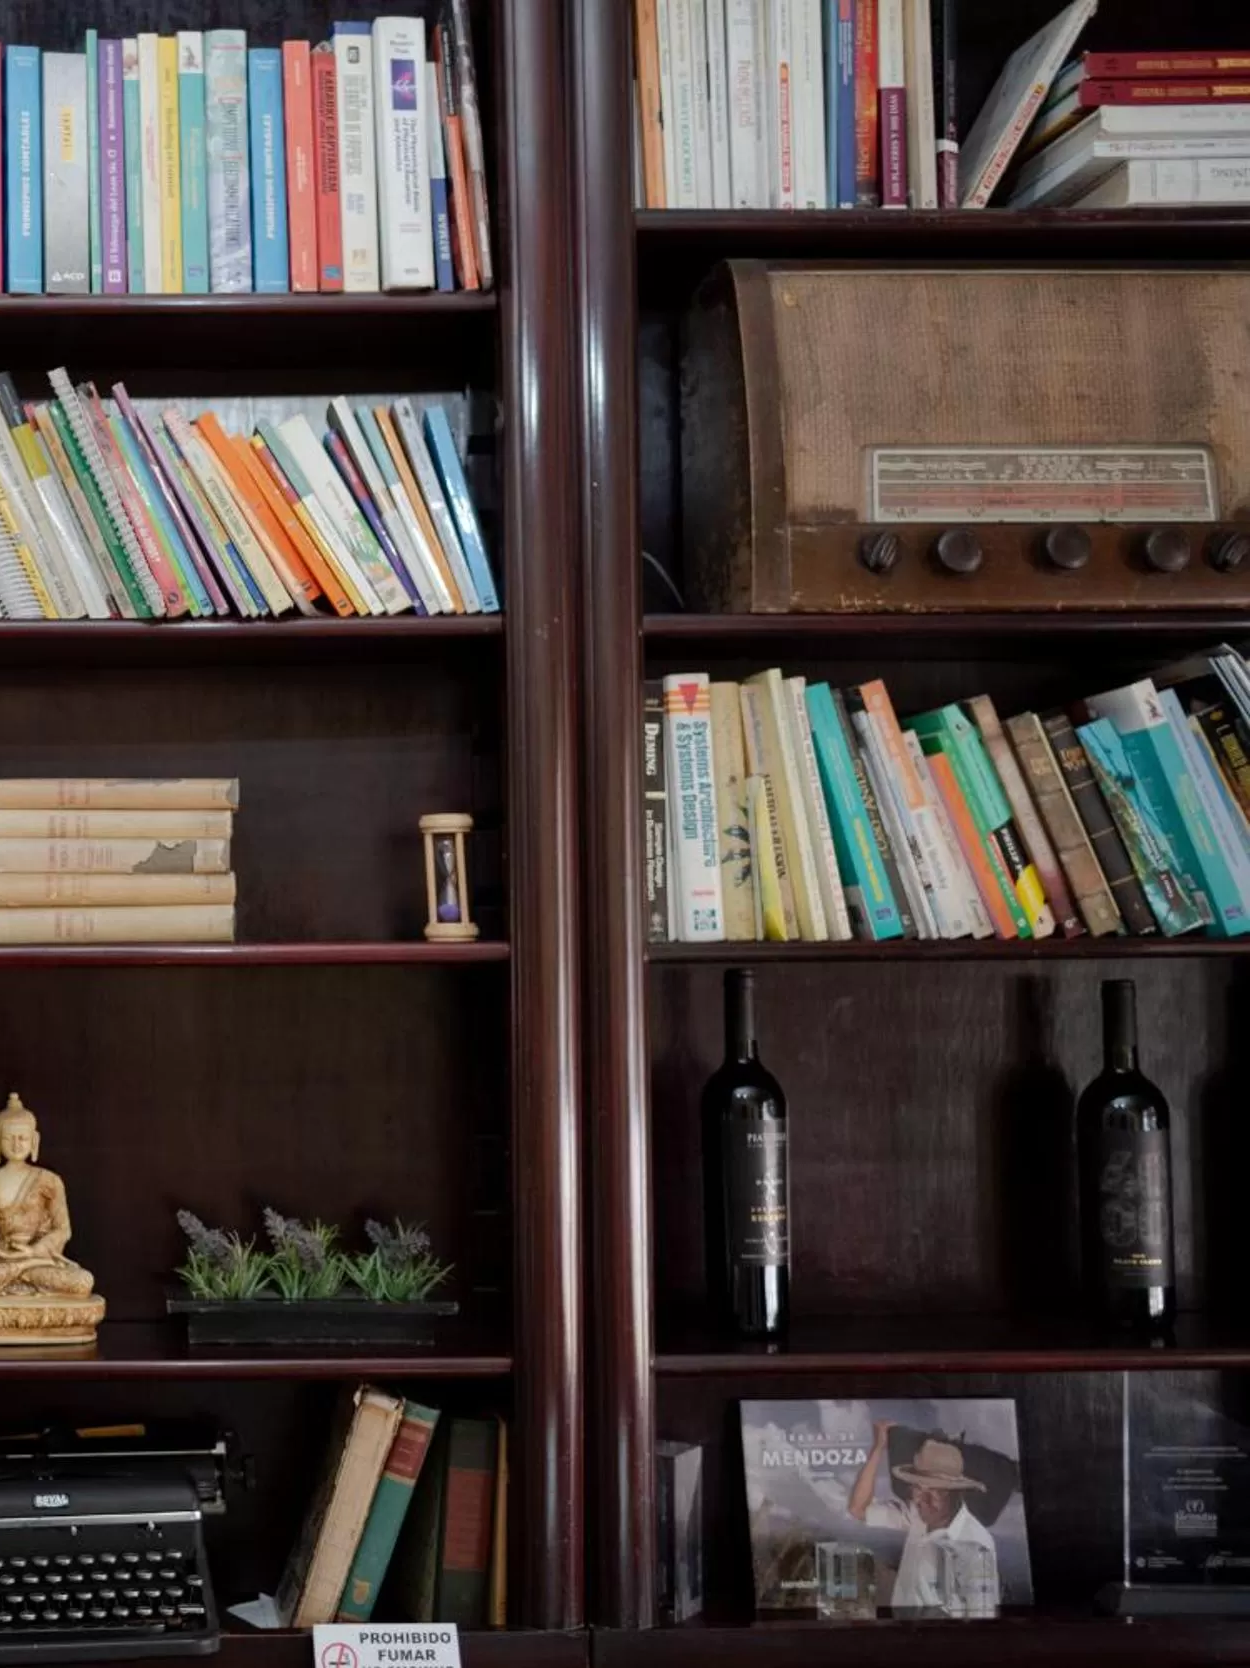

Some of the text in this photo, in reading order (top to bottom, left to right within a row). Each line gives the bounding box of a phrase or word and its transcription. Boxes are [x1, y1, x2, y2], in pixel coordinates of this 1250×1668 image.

[324, 70, 336, 122] KARAOKE
[328, 126, 338, 192] CAPITALISM
[438, 213, 450, 260] BATMAN
[645, 722, 660, 776] DEMING
[677, 734, 694, 792] Systems
[693, 721, 710, 779] Systems
[682, 794, 698, 840] Design
[762, 1448, 868, 1466] MENDOZA
[378, 1650, 436, 1661] FUMAR
